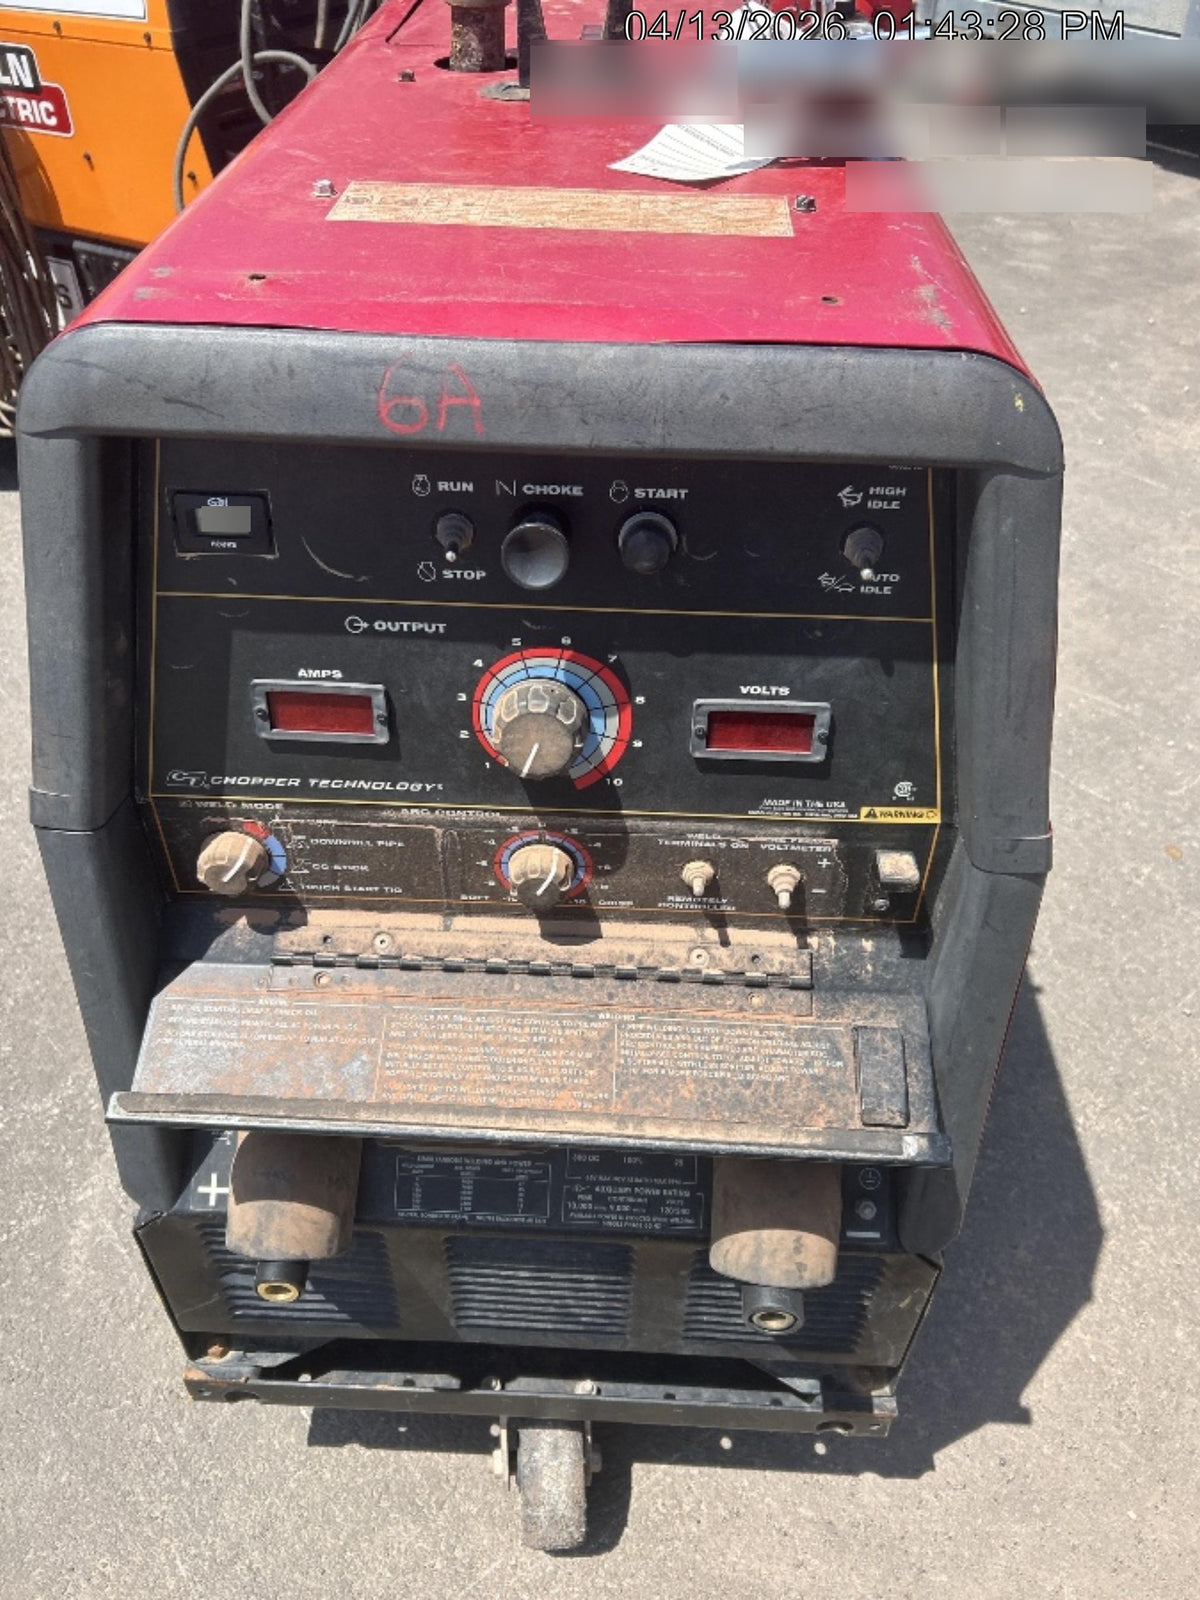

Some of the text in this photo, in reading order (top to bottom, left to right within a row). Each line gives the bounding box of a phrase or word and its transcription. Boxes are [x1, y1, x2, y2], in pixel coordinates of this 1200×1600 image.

[377, 350, 484, 435] 6A
[437, 481, 474, 492] RUN
[522, 484, 584, 497] CHOKE
[634, 488, 689, 499] START
[868, 486, 907, 497] HIGH
[866, 500, 901, 509] IDLE
[442, 569, 486, 580] STOP
[862, 573, 901, 582] UTO
[860, 586, 893, 595] IDLE
[373, 620, 447, 633] OUTPUT
[511, 637, 522, 646] 5
[561, 636, 571, 645] 6
[472, 658, 484, 667] 4
[607, 654, 618, 663] 7
[297, 667, 344, 679] AMPS
[739, 685, 790, 696] VOLTS
[457, 692, 467, 701] 3
[634, 695, 646, 704] 8
[459, 729, 471, 739] 2
[484, 761, 490, 769] 1
[210, 775, 301, 788] CHOPPER
[605, 777, 623, 787] 10
[196, 801, 238, 809] WELD
[792, 799, 803, 808] IN
[400, 808, 431, 816] ARC
[880, 810, 924, 819] WARNING
[310, 838, 374, 847] DOWNHILL
[657, 838, 727, 848] TERMINALS
[760, 843, 832, 853] VOLTMETER
[667, 895, 728, 904] REMOTELY
